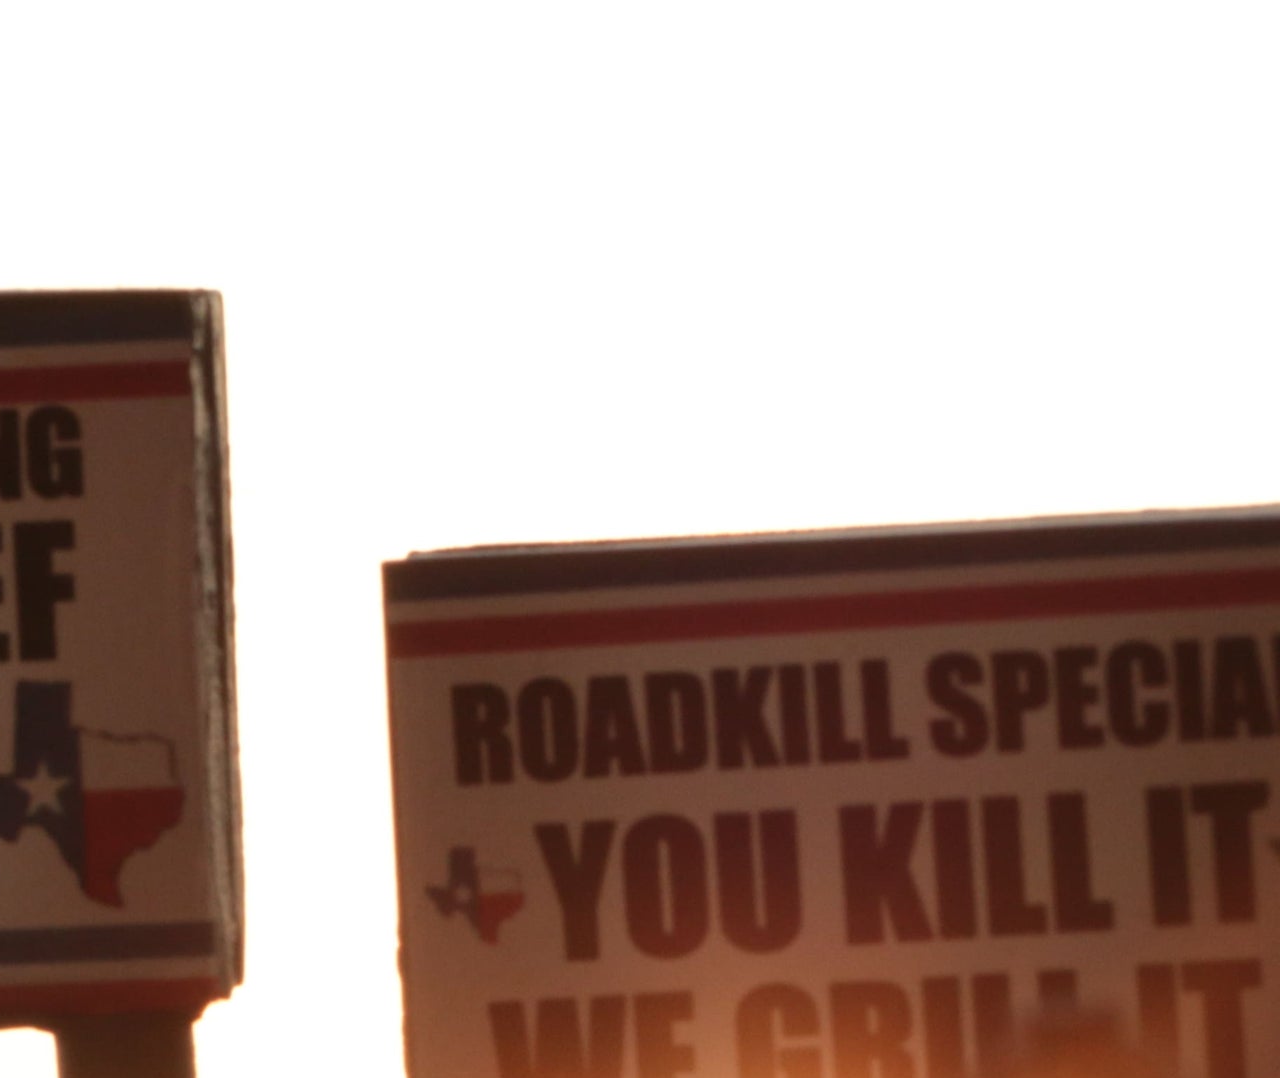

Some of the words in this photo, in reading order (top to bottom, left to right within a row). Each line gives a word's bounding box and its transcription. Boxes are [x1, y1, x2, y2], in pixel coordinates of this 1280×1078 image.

[450, 658, 911, 788] ROADKILL
[924, 633, 1280, 758] SPECIA
[532, 809, 803, 962] YOU
[839, 791, 1115, 946] KILL
[1143, 780, 1271, 928] IT
